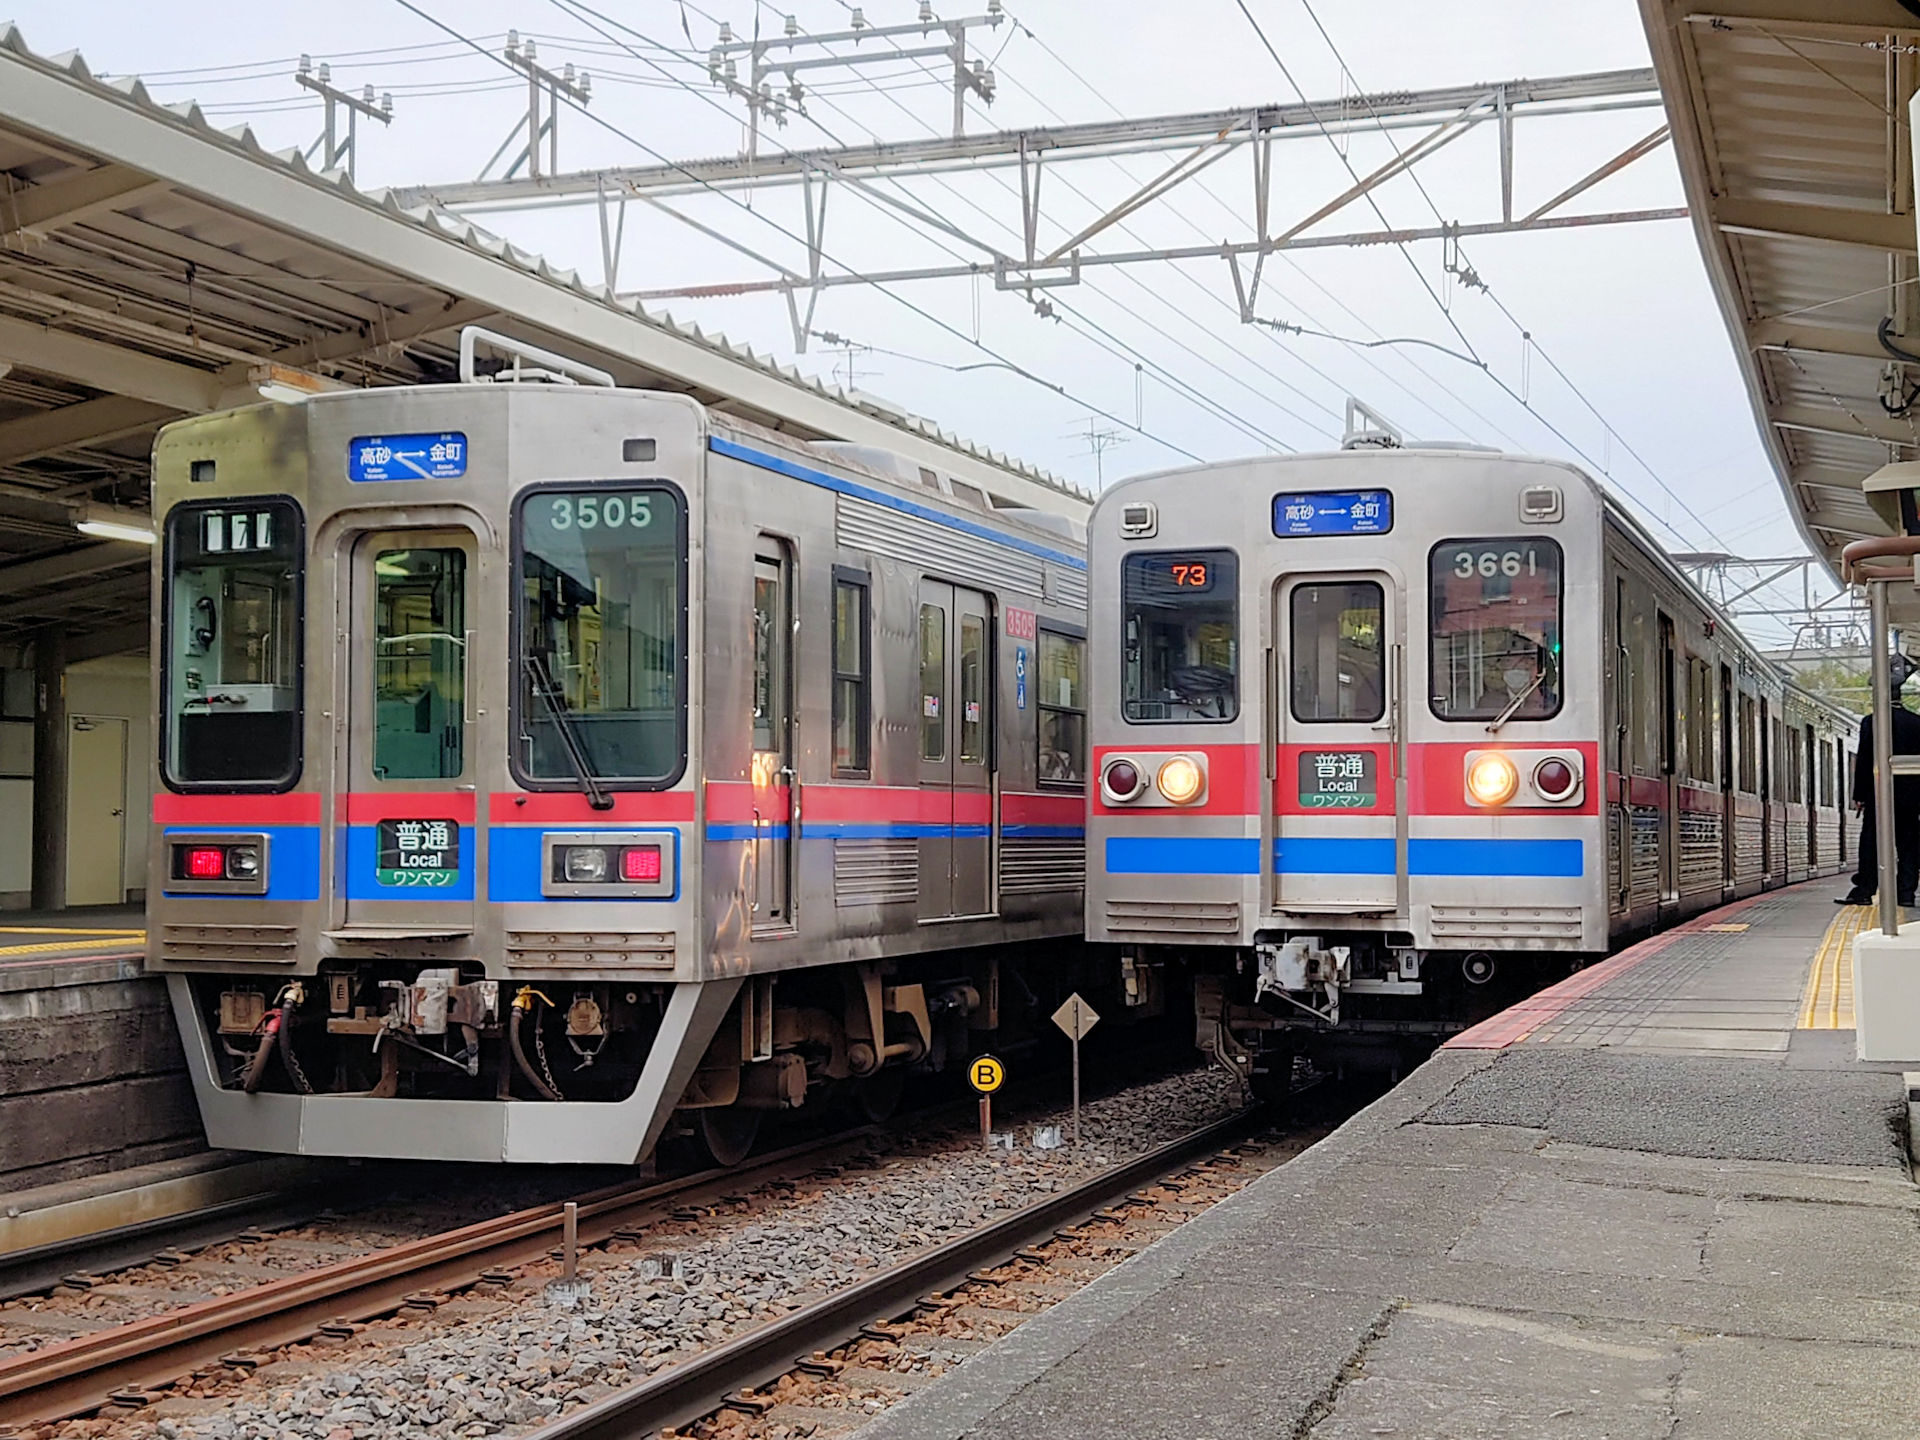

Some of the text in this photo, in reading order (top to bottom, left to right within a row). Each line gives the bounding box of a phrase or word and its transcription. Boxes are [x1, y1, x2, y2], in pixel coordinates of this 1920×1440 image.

[360, 443, 462, 466] 高砂 金町
[551, 496, 652, 530] 3505
[1285, 502, 1380, 521] 高砂 金町
[1454, 550, 1536, 578] 3661
[1172, 565, 1206, 586] 73
[1008, 609, 1034, 638] 3505
[1314, 753, 1364, 778] 普通
[1319, 779, 1358, 793] Local
[1313, 794, 1366, 807] ワンマン
[395, 821, 449, 850] 普通
[400, 851, 442, 868] Local
[393, 871, 450, 886] ワンマン
[978, 1065, 995, 1084] B
